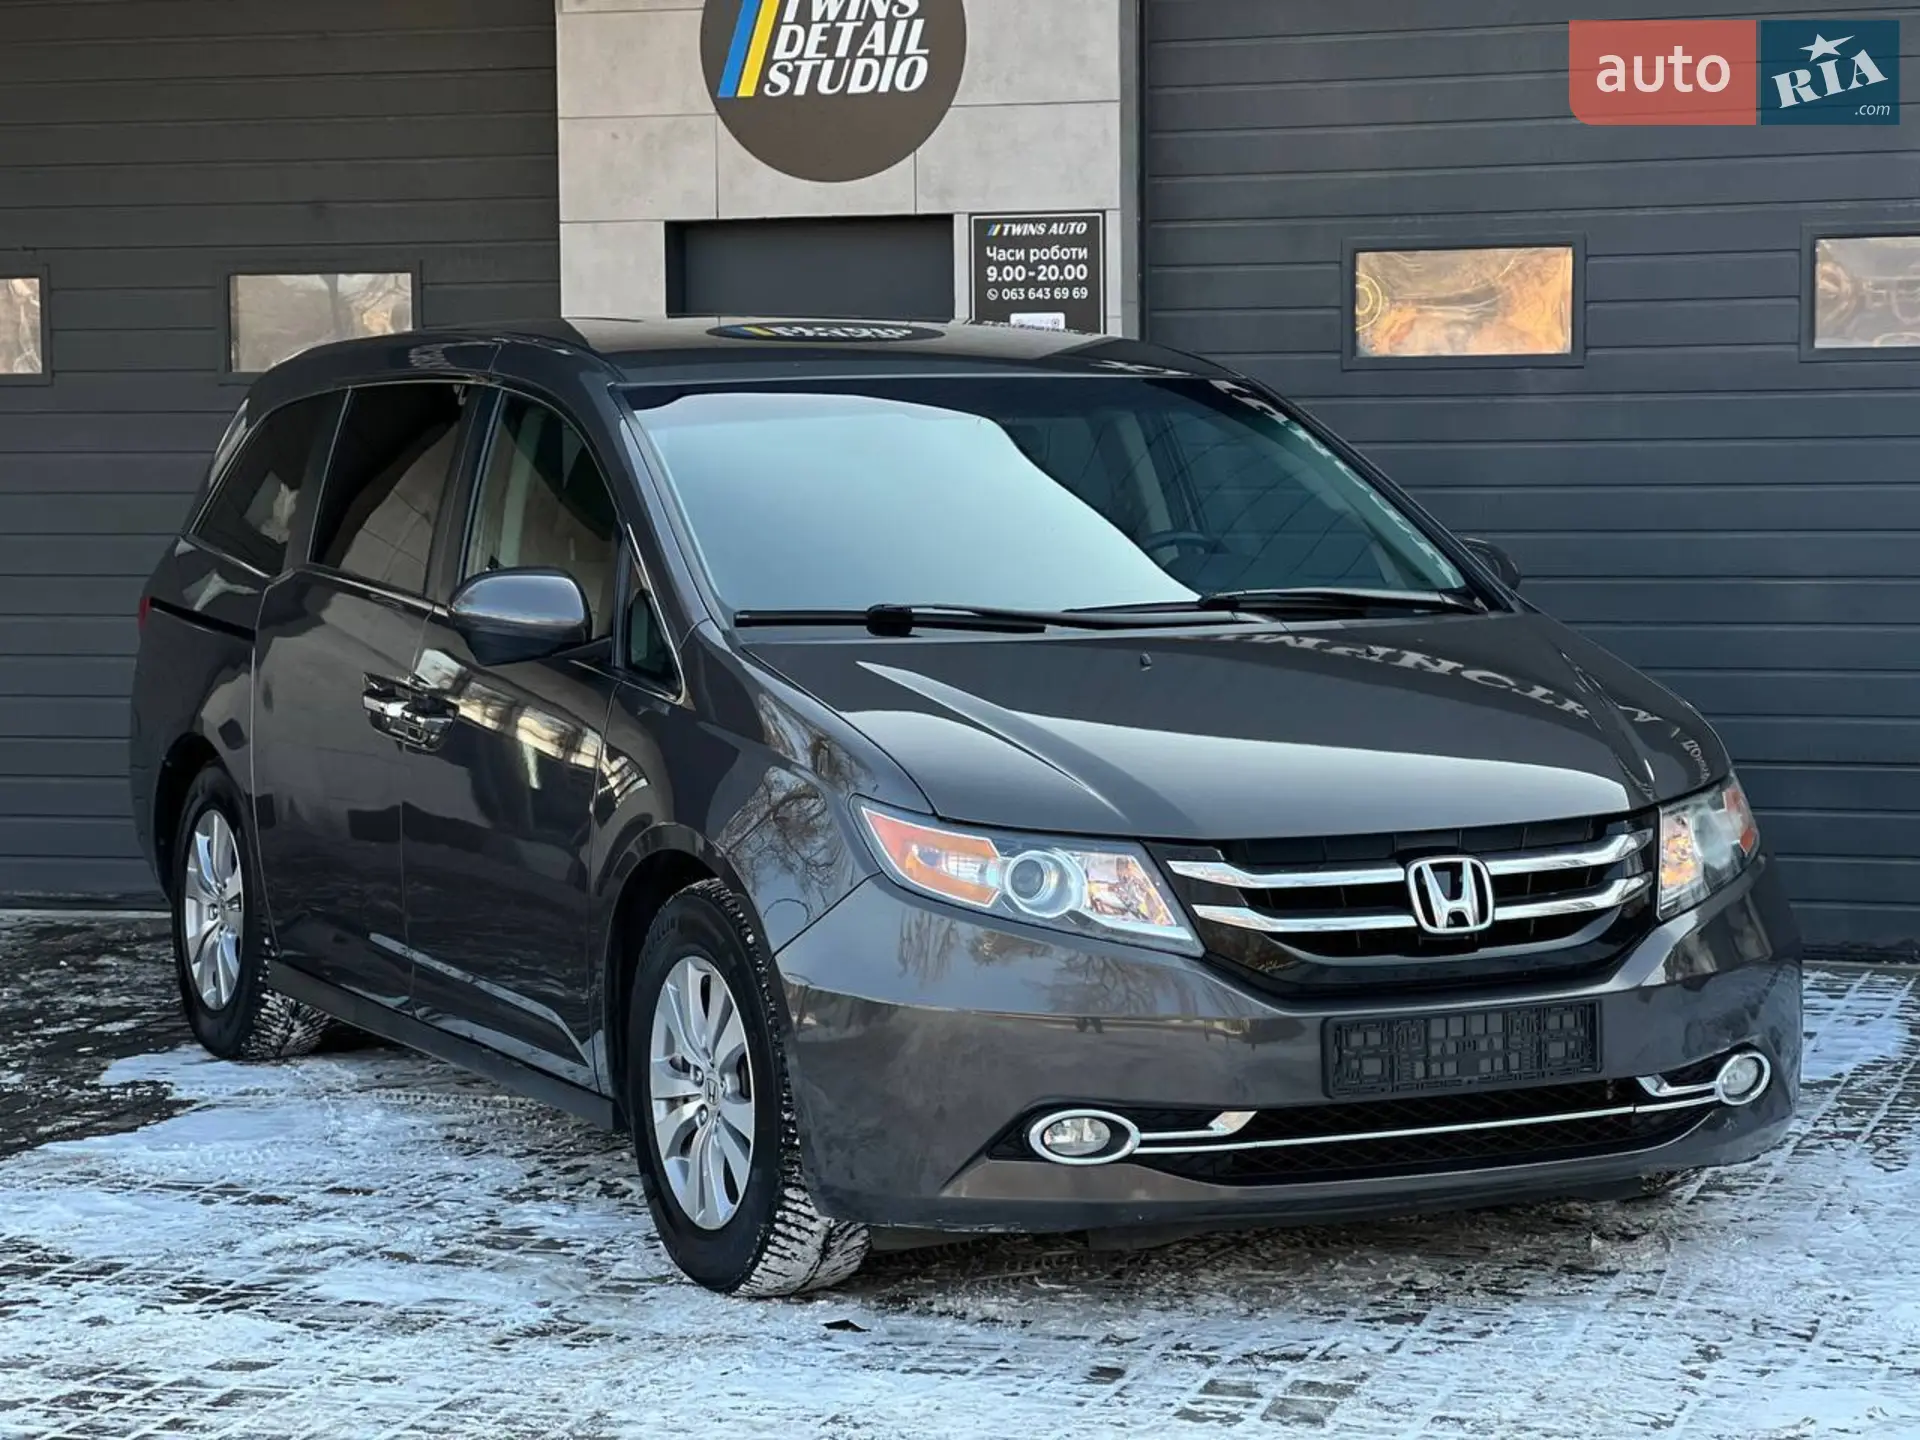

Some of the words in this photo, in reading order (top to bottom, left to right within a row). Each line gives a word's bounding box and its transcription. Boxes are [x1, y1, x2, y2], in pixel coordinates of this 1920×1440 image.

[772, 19, 930, 60] DETAIL
[763, 56, 929, 97] STUDIO
[1001, 223, 1047, 236] TWINS
[1048, 222, 1088, 236] AUTO
[986, 246, 1025, 261] Часи
[1029, 244, 1088, 263] роботи
[1001, 287, 1025, 300] 063
[1028, 287, 1051, 300] 643
[1053, 287, 1069, 299] 69
[1071, 287, 1088, 299] 69
